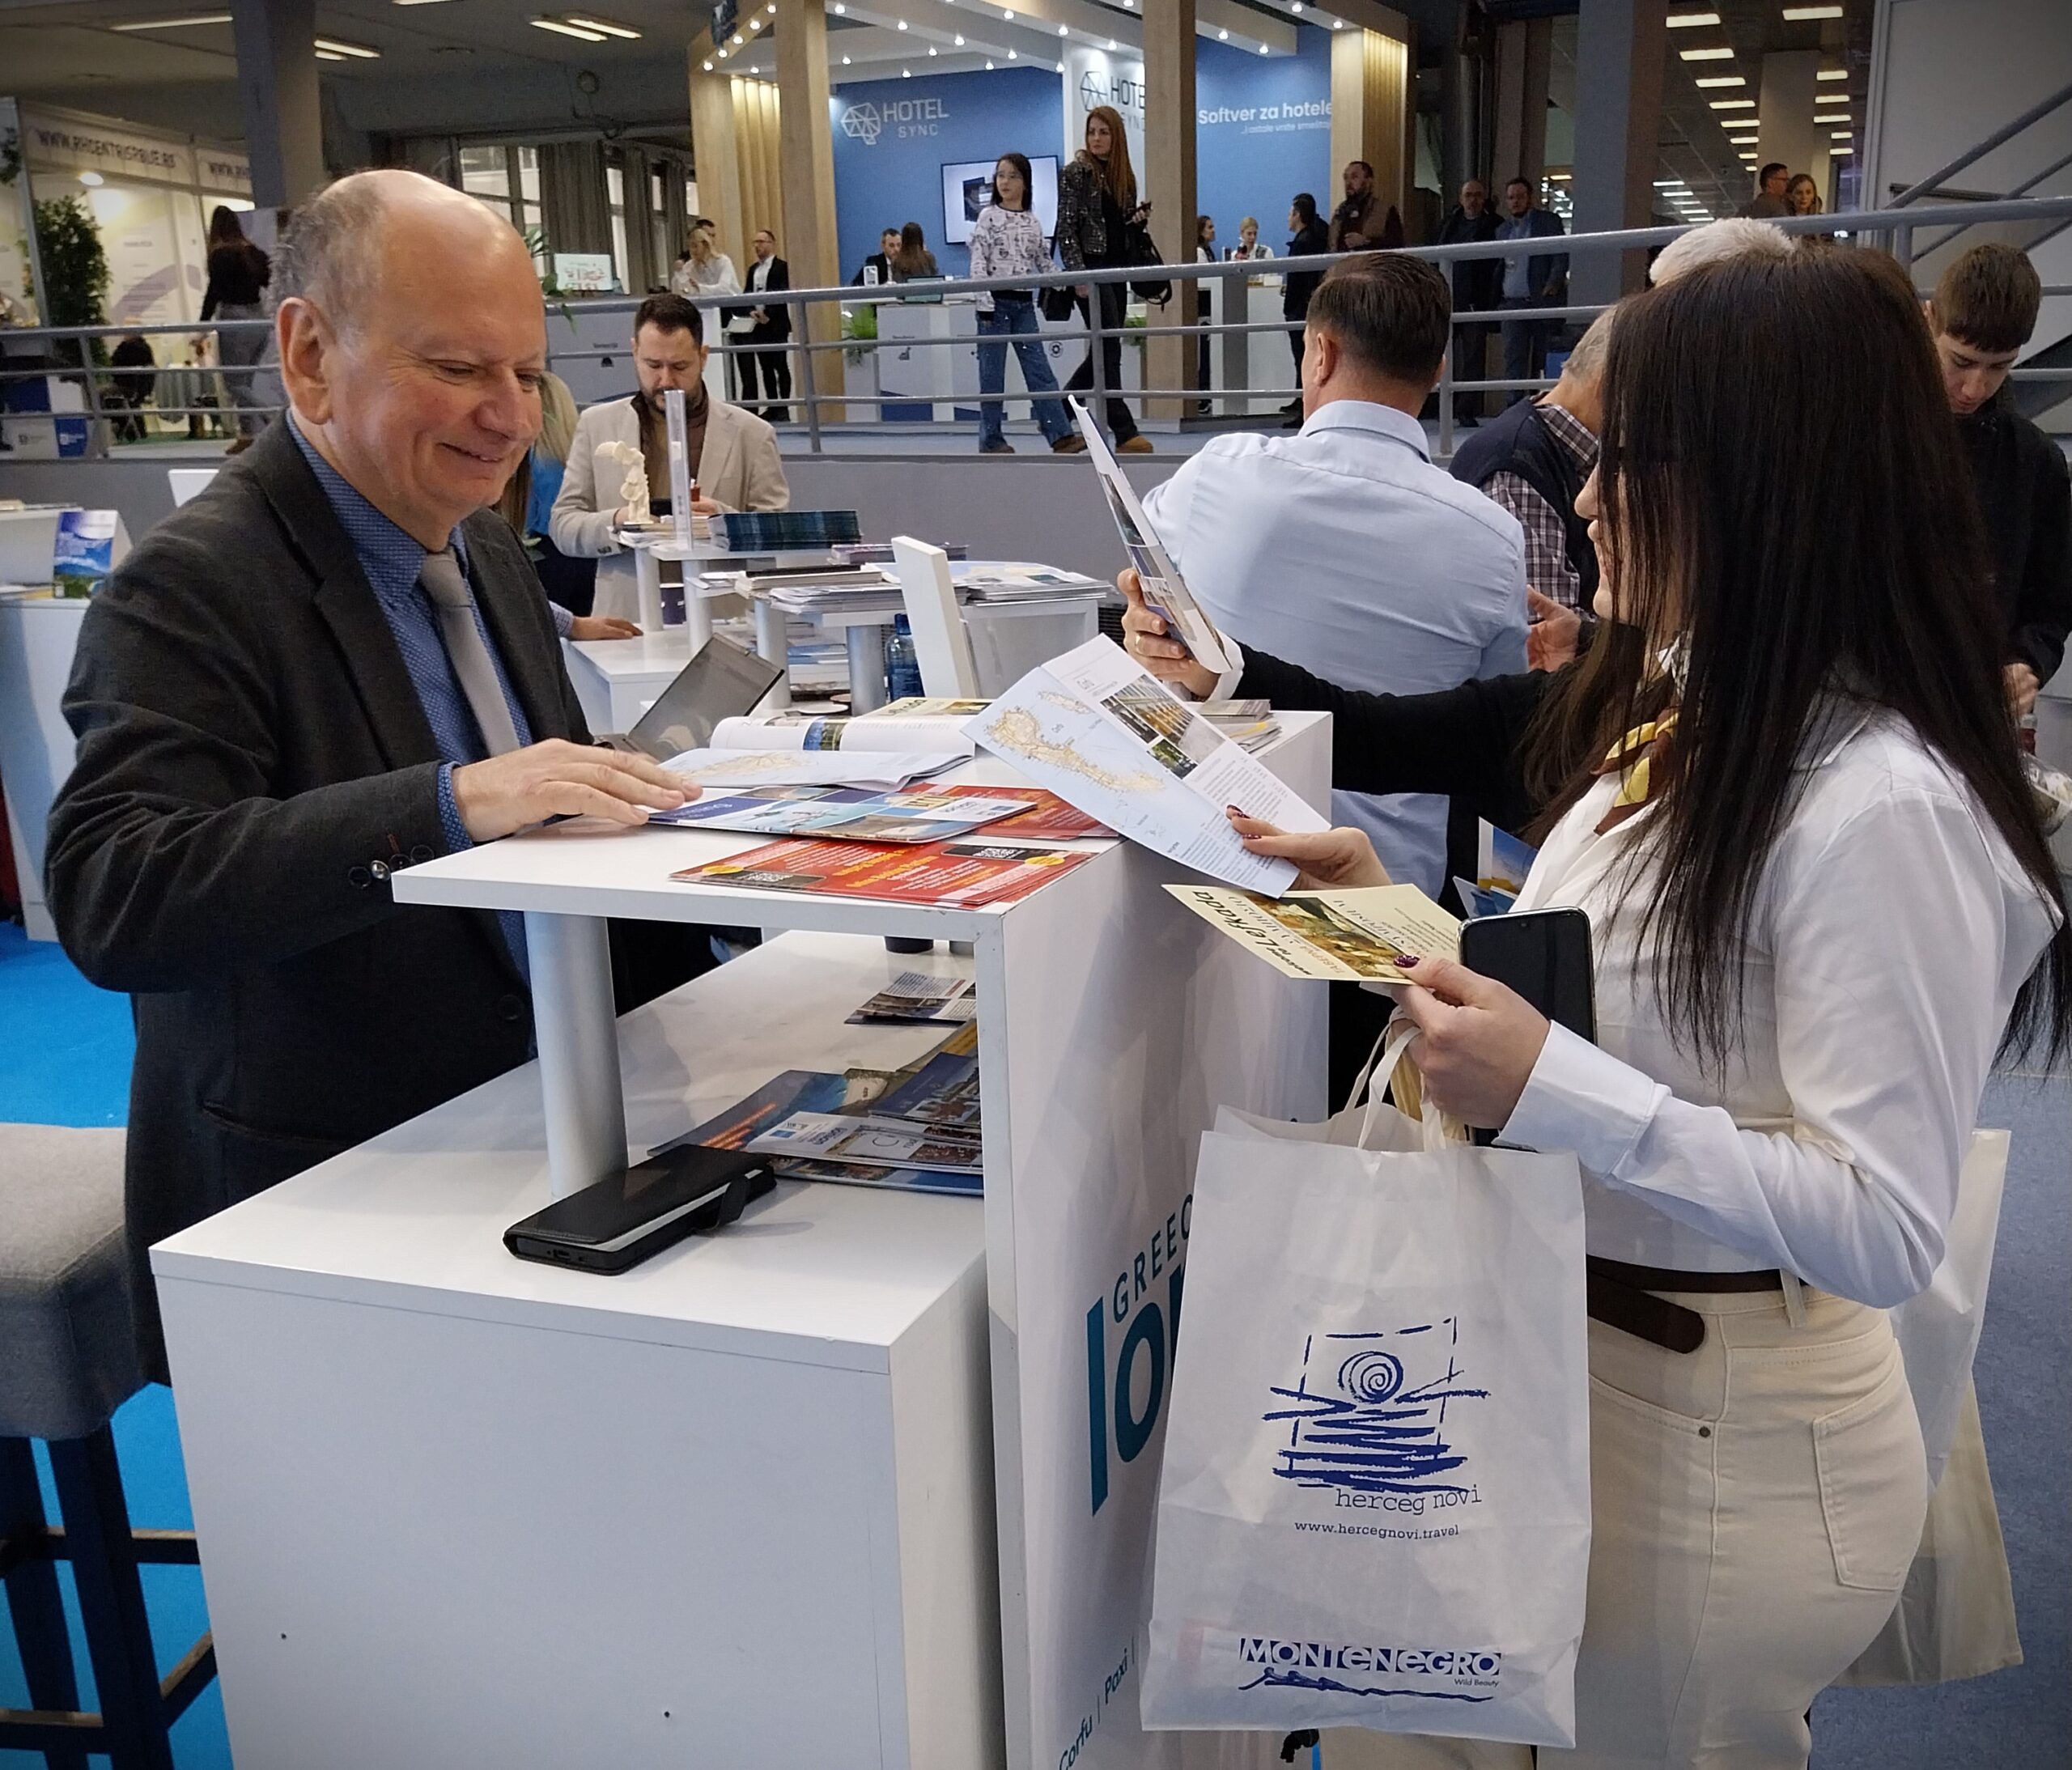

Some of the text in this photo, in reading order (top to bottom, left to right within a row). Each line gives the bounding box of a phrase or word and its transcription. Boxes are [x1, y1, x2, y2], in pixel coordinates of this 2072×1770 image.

[1110, 76, 1145, 109] HOTE
[882, 99, 950, 122] HOTEL
[1198, 99, 1332, 125] Softver za hotele
[898, 124, 939, 138] SYNC
[1192, 890, 1280, 948] Lefkada
[1113, 1194, 1193, 1324] GREEC
[1335, 1483, 1483, 1516] herceg novi
[1294, 1522, 1459, 1540] www.hercegnovi.travel
[1454, 1678, 1500, 1688] Wild Beauty
[1059, 1647, 1128, 1770] Corfu Paxi
